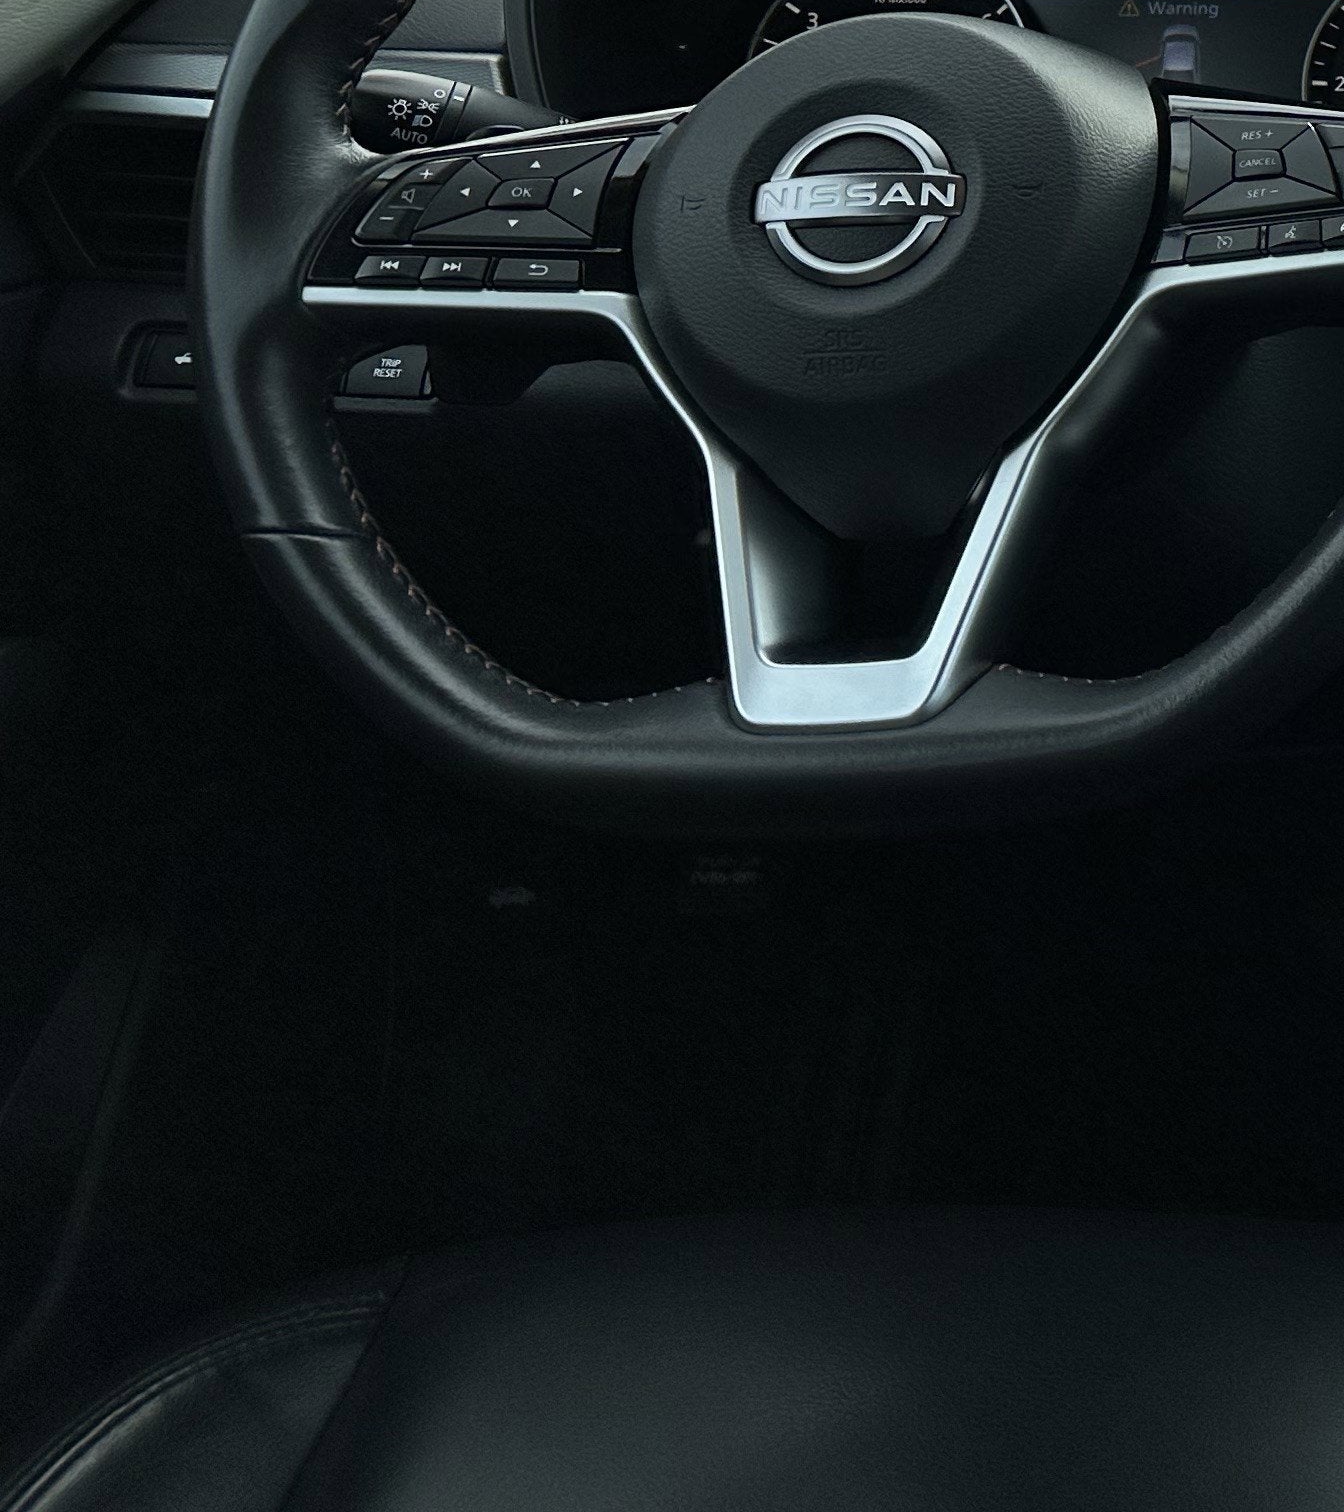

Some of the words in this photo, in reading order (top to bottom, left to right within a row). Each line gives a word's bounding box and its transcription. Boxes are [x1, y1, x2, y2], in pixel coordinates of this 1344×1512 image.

[1148, 1, 1219, 19] Warning
[806, 12, 819, 30] 3
[390, 127, 428, 145] AUTO
[1241, 131, 1262, 141] RES
[1239, 157, 1276, 169] CANCEL
[511, 186, 532, 198] OK
[1246, 188, 1266, 199] SET
[759, 181, 956, 216] NISSAN
[380, 357, 402, 368] TRIP
[373, 368, 402, 379] RESET
